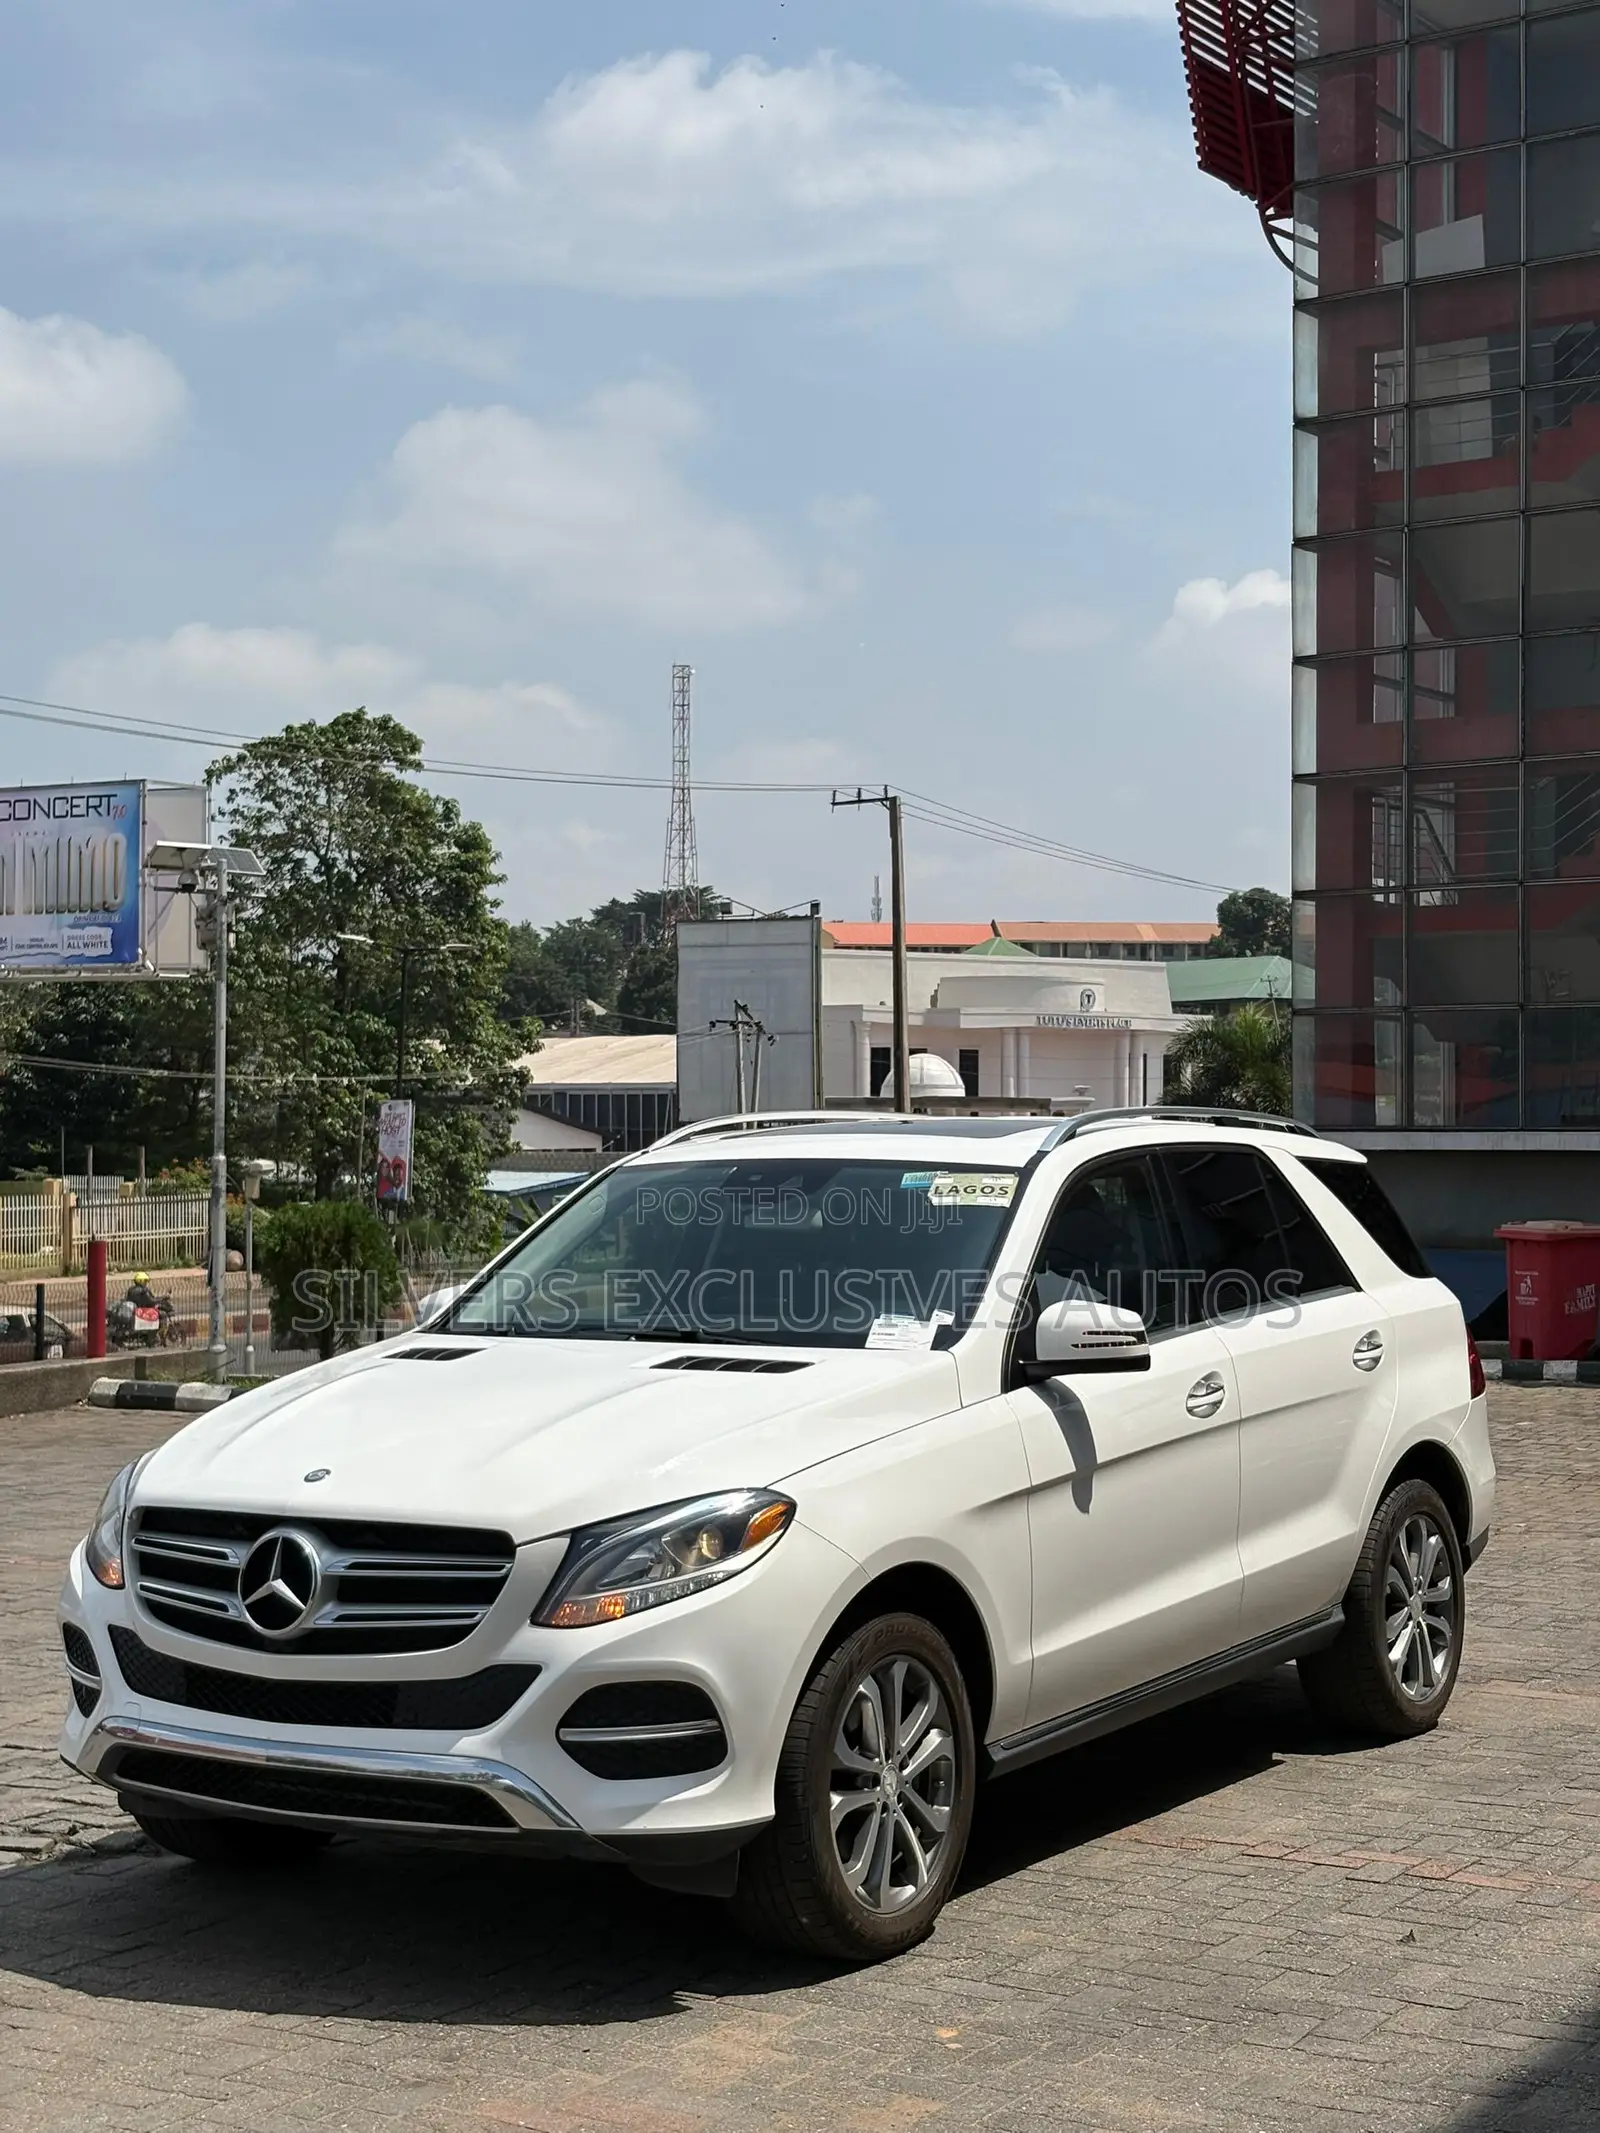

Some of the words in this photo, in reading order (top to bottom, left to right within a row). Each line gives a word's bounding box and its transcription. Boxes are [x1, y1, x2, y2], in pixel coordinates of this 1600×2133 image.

[83, 940, 108, 949] WHITE
[934, 1185, 1009, 1196] LAGOS
[1564, 1294, 1596, 1315] FAMILY
